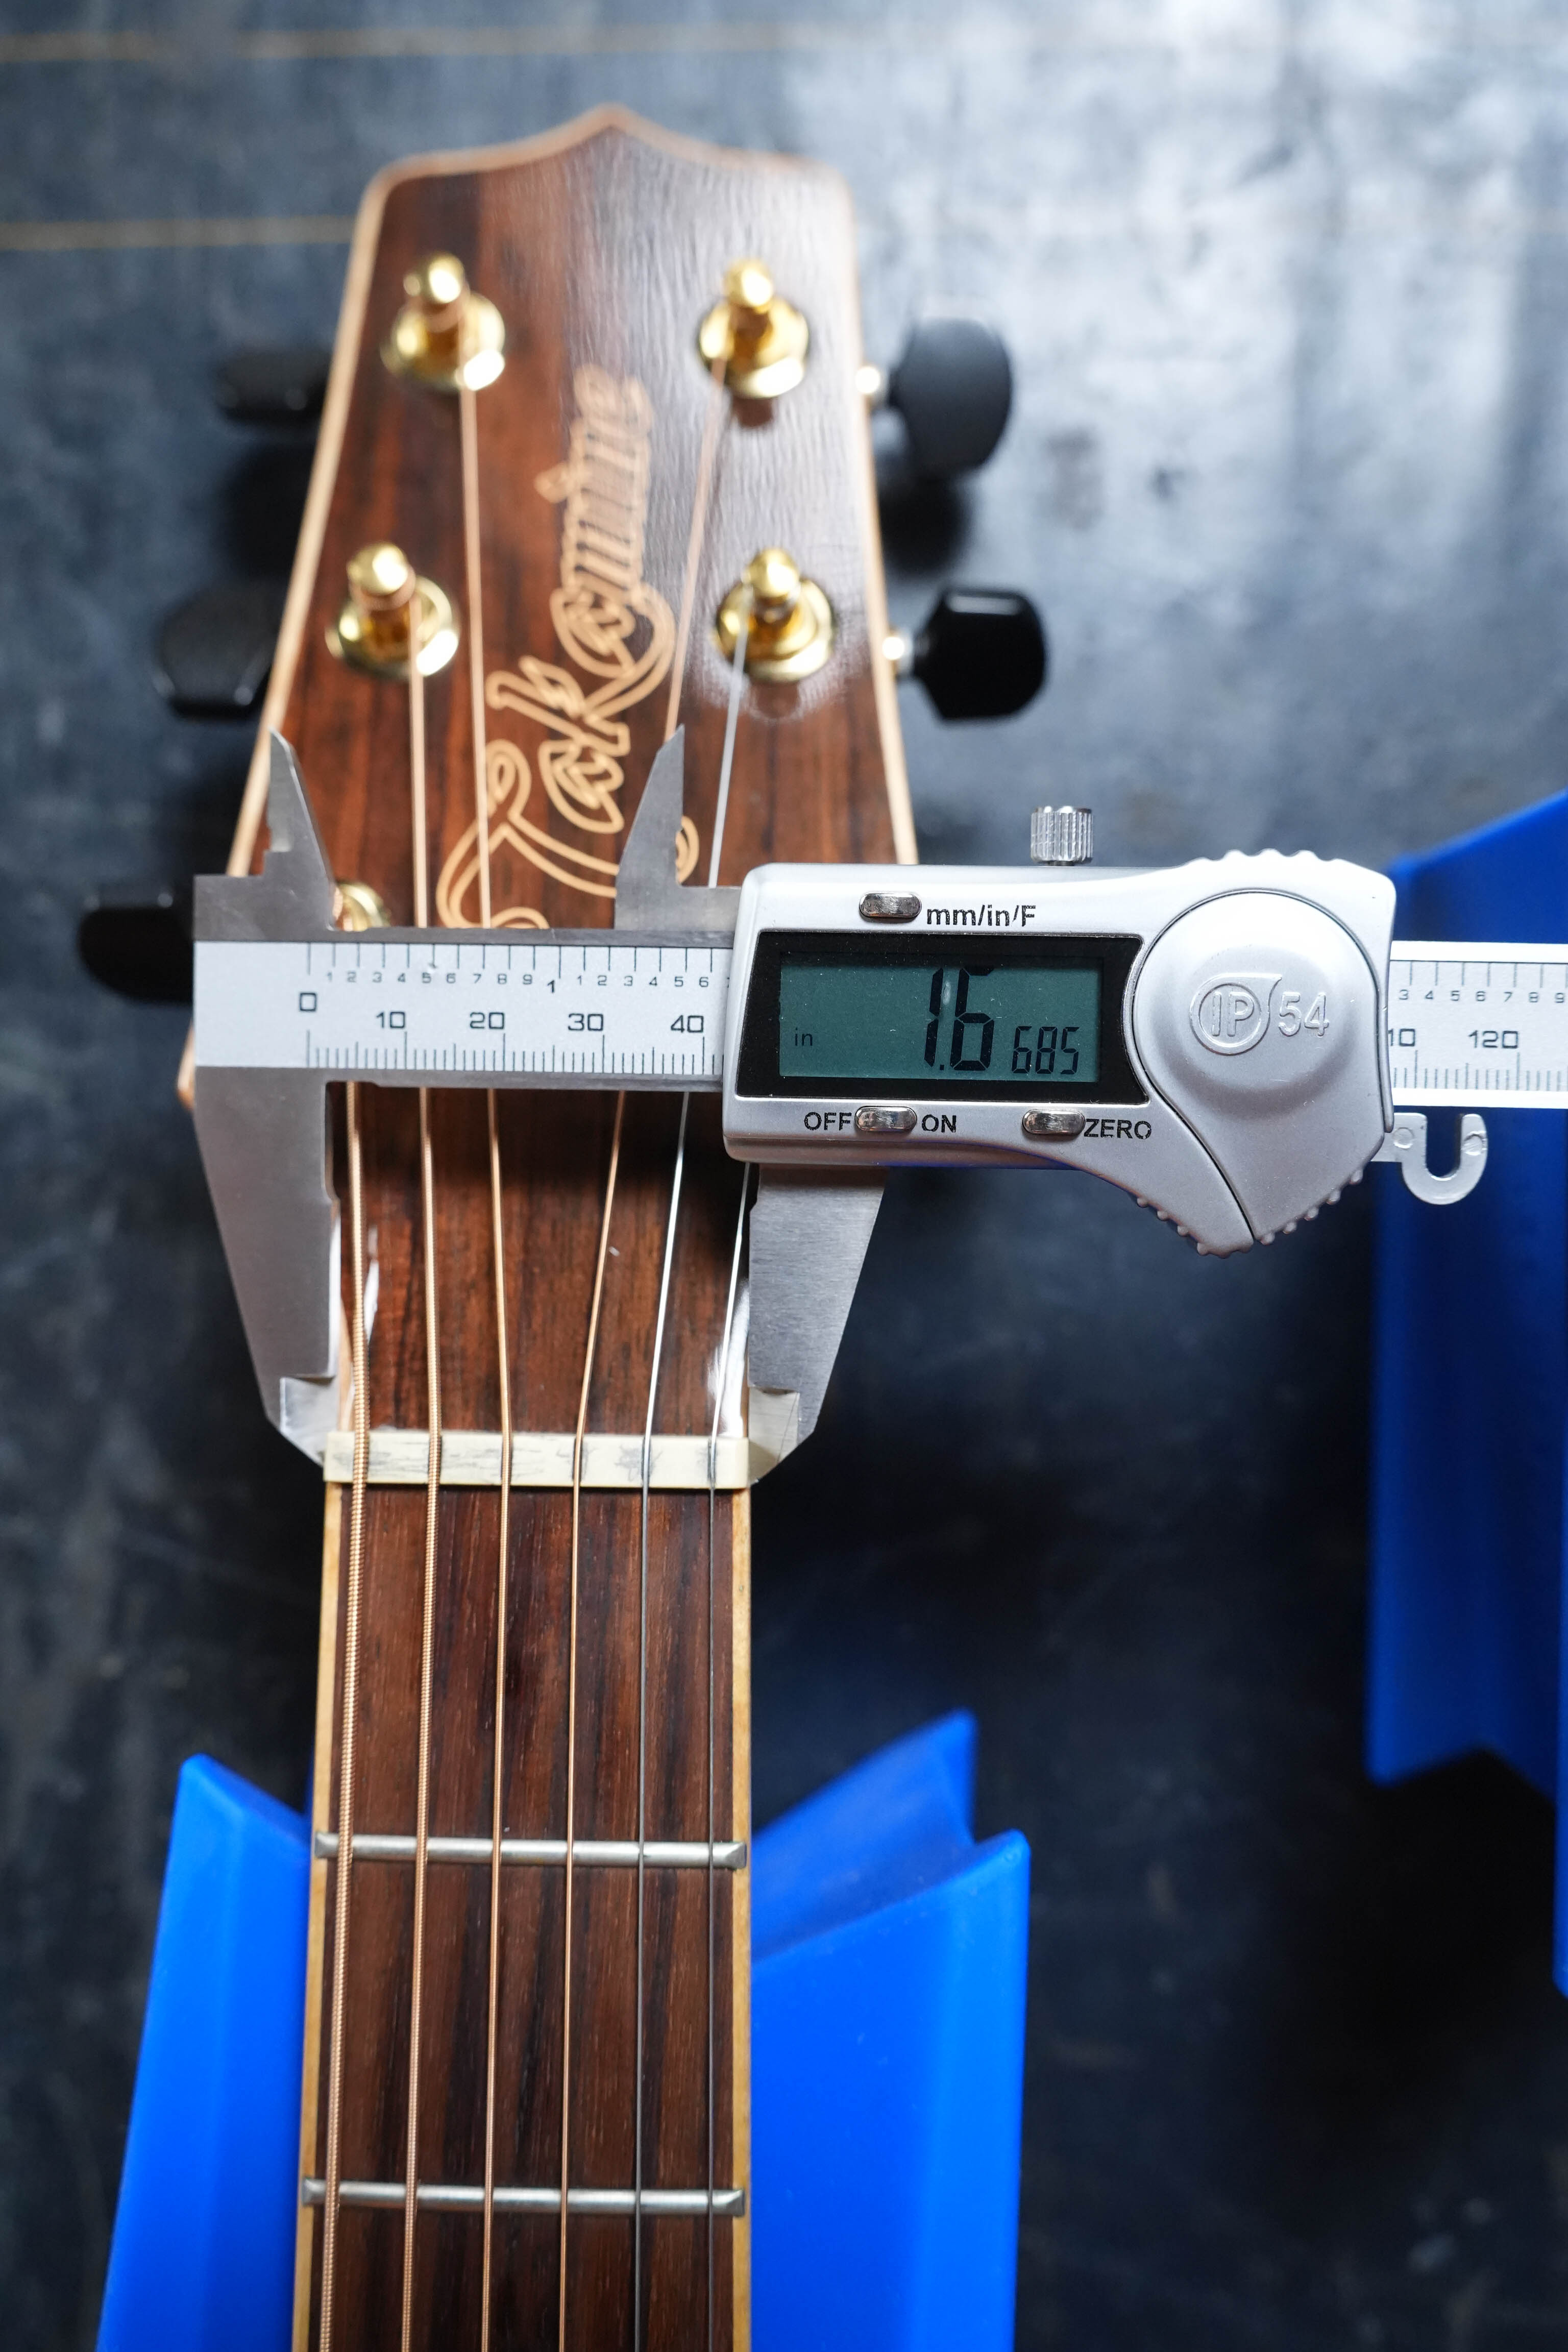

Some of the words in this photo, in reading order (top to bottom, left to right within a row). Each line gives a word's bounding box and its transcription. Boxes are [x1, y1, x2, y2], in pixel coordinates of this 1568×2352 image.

[926, 903, 1037, 927] mm/in/F
[327, 971, 332, 981] 1
[347, 971, 357, 983] 2
[372, 971, 382, 983] 3
[397, 972, 406, 983] 4
[421, 972, 431, 984] 5
[446, 972, 456, 984] 6
[473, 973, 482, 984] 7
[497, 973, 508, 985] 8
[522, 973, 533, 986] 9
[547, 979, 556, 994] 1
[577, 975, 582, 986] 1
[597, 974, 607, 987] 2
[623, 975, 633, 987] 3
[648, 975, 658, 987] 4
[674, 975, 684, 988] 5
[698, 976, 709, 988] 6
[1398, 989, 1409, 1001] 3
[1424, 990, 1435, 1001] 4
[1450, 990, 1461, 1002] 5
[1475, 990, 1487, 1002] 6
[1503, 991, 1513, 1003] 7
[1528, 991, 1540, 1003] 8
[1554, 992, 1566, 1004] 9
[298, 991, 318, 1013] 0
[376, 1011, 406, 1030] 10
[469, 1011, 505, 1031] 20
[567, 1013, 604, 1032] 30
[670, 1014, 705, 1034] 40
[1211, 991, 1255, 1037] IP
[1278, 991, 1330, 1038] 54
[794, 1027, 813, 1046] in
[1387, 1028, 1416, 1047] 10
[1467, 1030, 1520, 1050] 120
[803, 1111, 852, 1132] OFF
[921, 1114, 957, 1134] ON
[1083, 1117, 1152, 1140] ZERO
